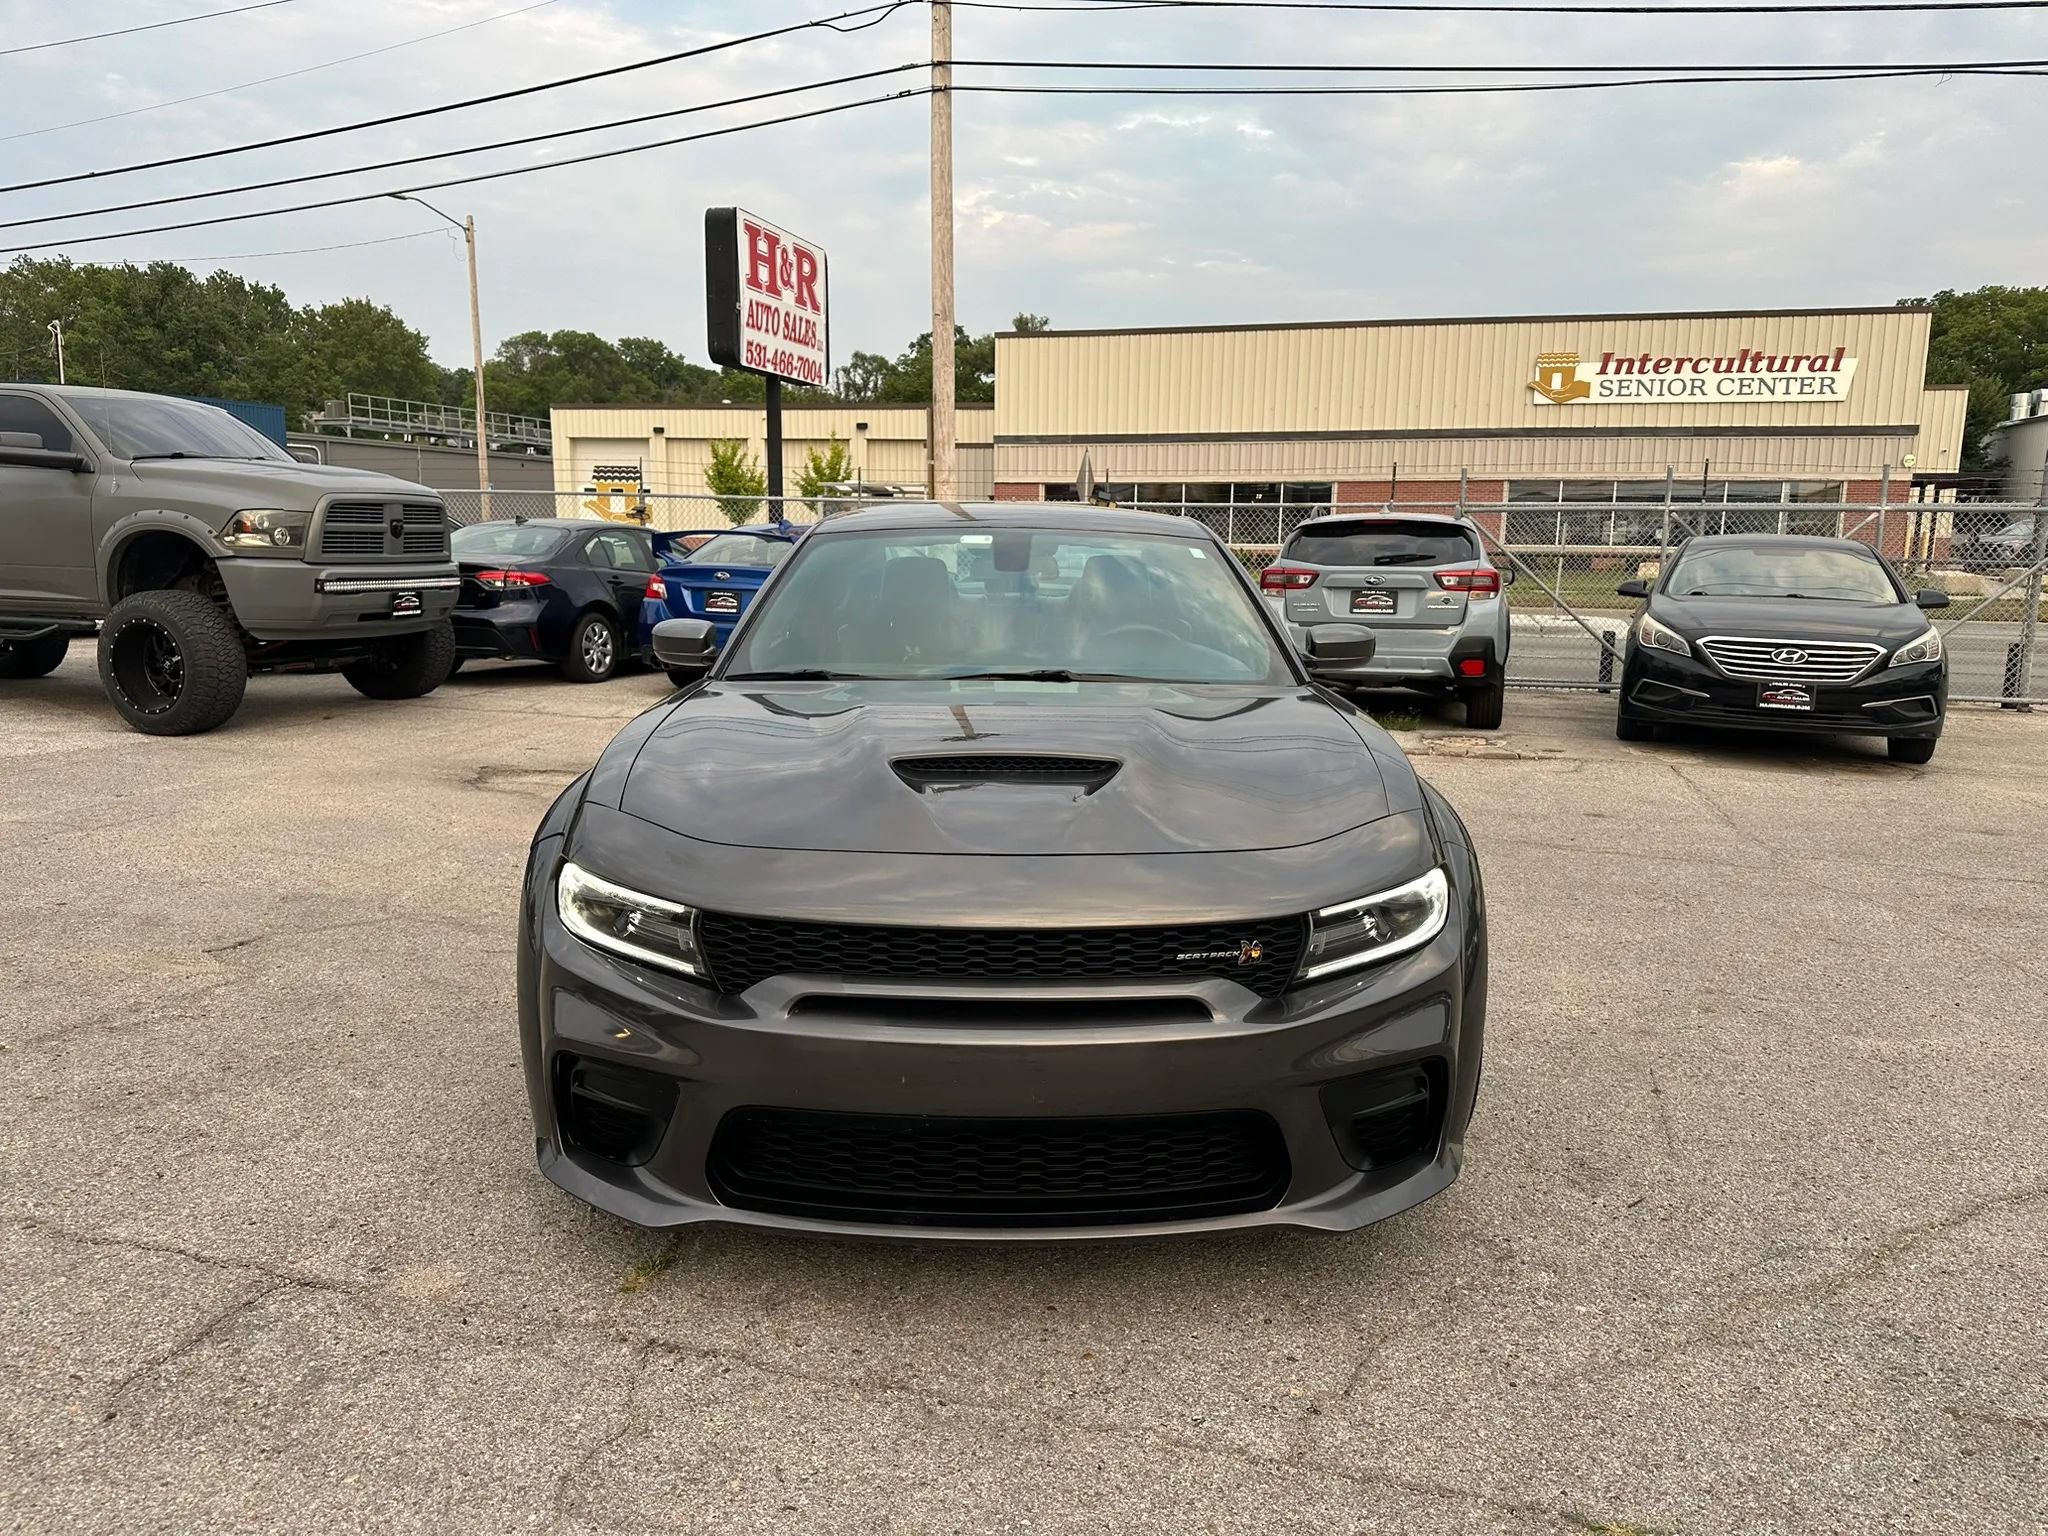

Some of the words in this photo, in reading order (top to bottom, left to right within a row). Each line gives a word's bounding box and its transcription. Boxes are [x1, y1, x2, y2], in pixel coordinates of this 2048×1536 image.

[743, 219, 821, 316] H&R
[746, 299, 780, 337] AUTO
[783, 311, 817, 349] SALES
[746, 339, 823, 384] 531-466-7004
[1596, 347, 1846, 375] Intercultural
[1599, 378, 1708, 398] SENIOR
[1717, 376, 1838, 396] CENTER
[1209, 950, 1240, 959] PACK
